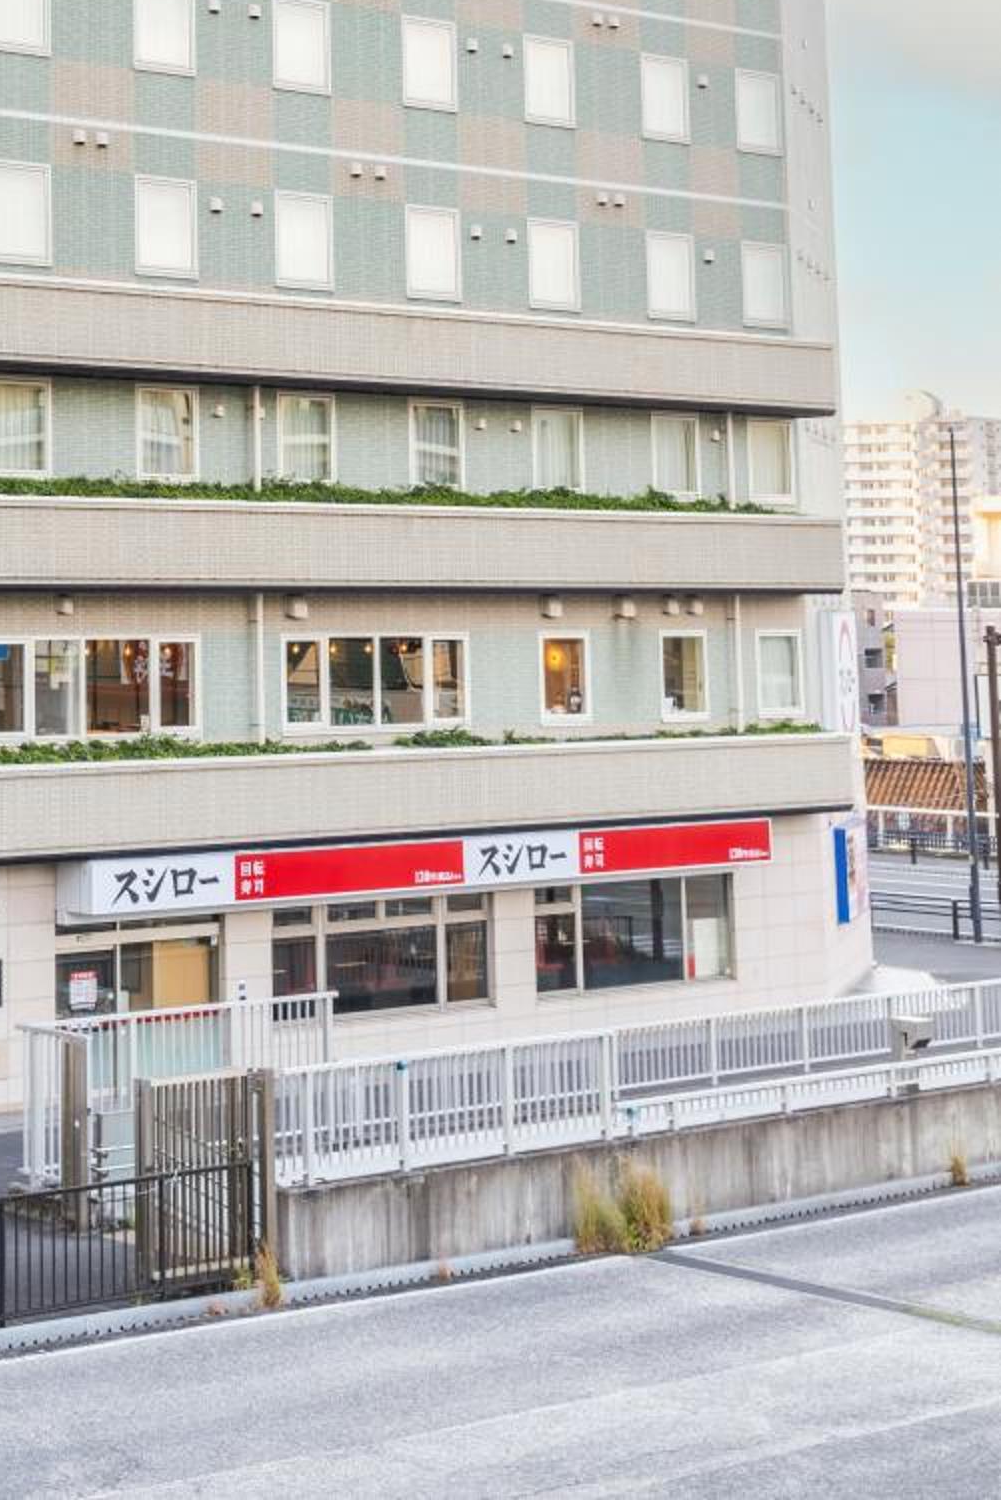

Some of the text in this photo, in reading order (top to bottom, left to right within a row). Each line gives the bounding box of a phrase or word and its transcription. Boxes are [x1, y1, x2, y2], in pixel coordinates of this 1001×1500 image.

[477, 840, 568, 878] スシロー
[110, 864, 220, 906] スシロー
